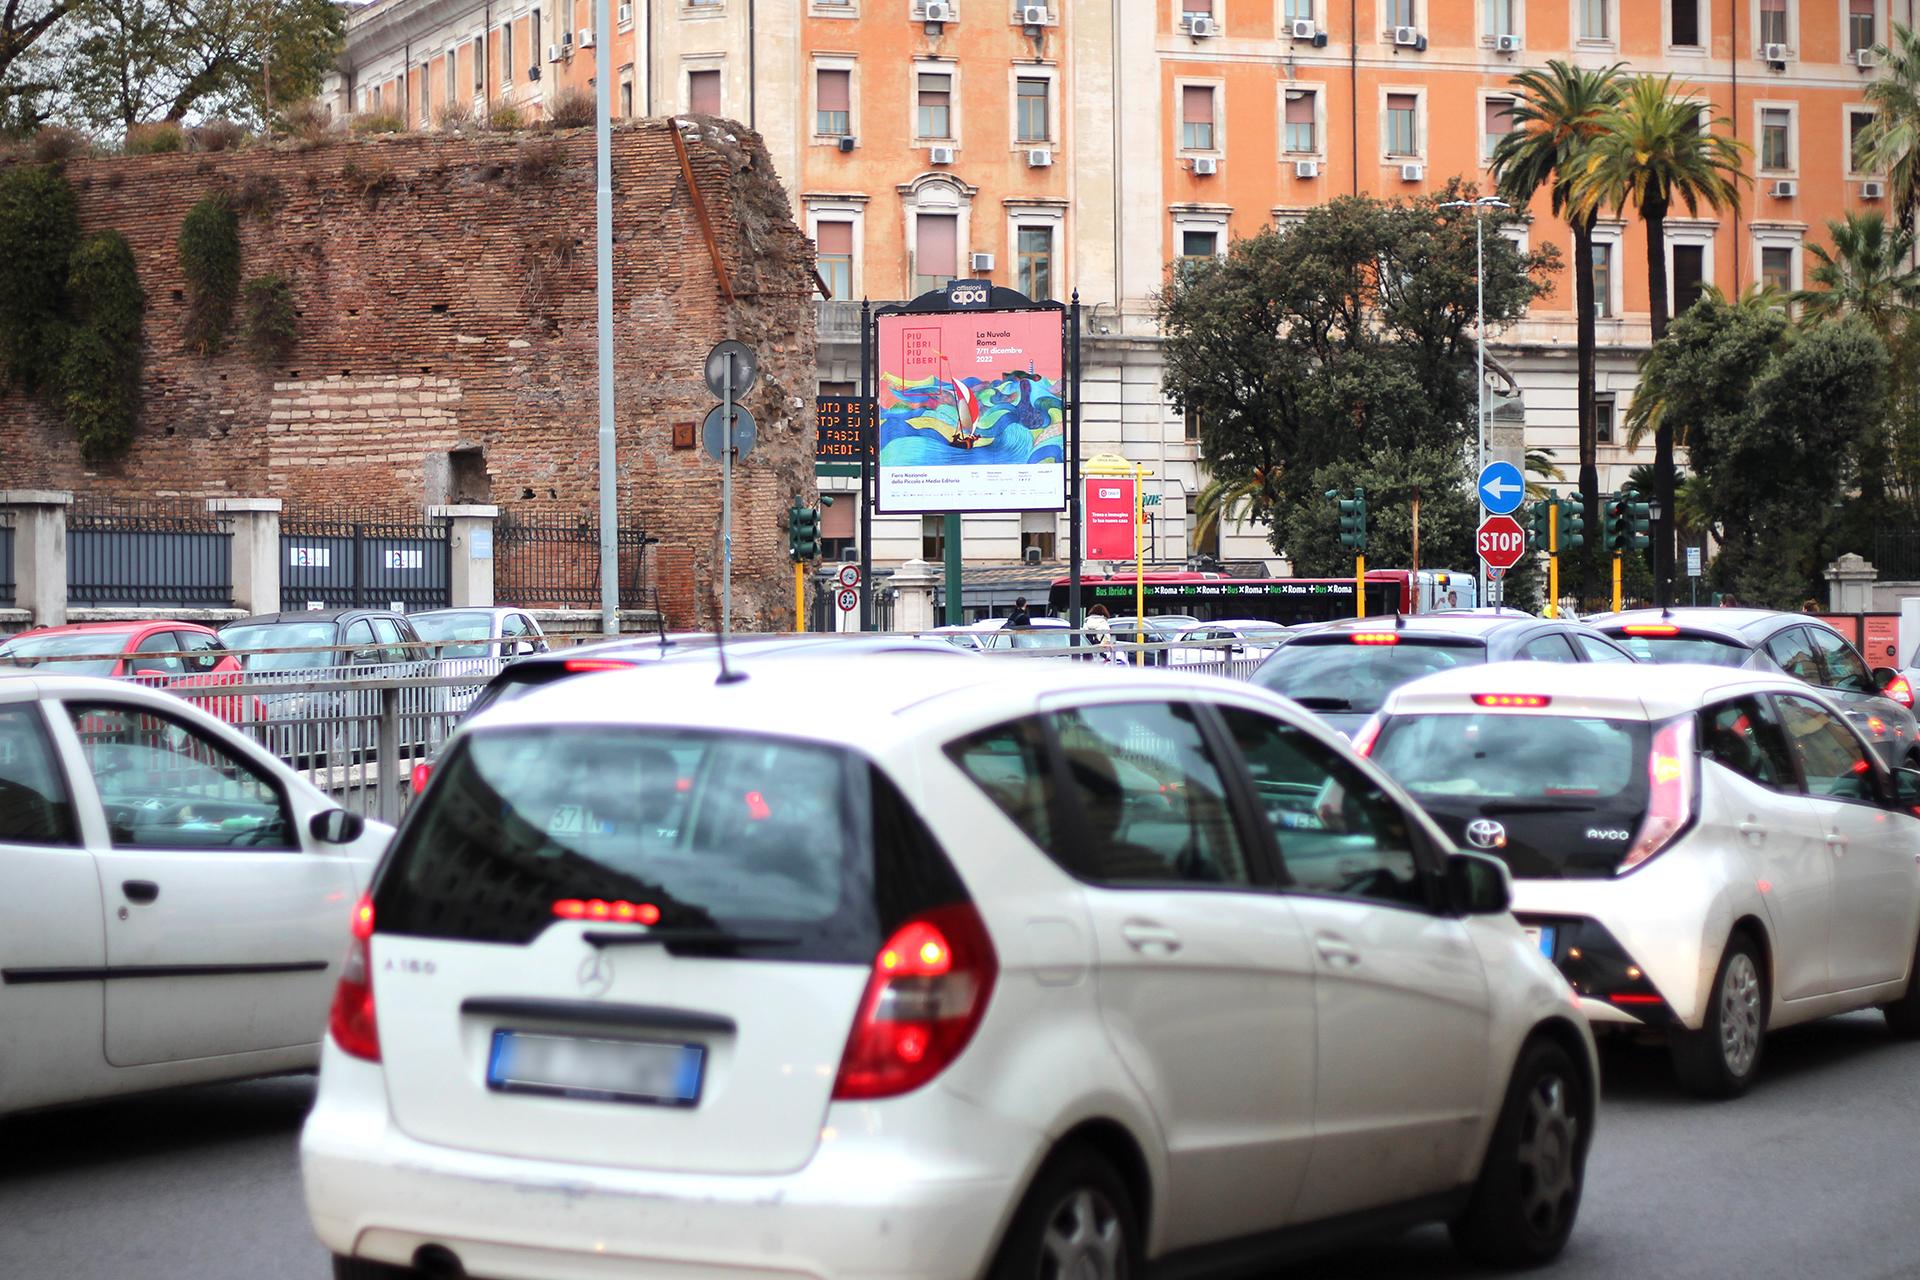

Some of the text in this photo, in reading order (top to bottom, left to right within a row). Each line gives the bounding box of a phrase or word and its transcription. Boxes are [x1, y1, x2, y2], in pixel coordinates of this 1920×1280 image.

[951, 290, 987, 305] apa
[976, 331, 985, 339] La
[976, 339, 997, 347] Roma
[907, 357, 937, 365] LIBERI
[976, 355, 993, 363] 2022
[1480, 532, 1522, 551] STOP
[1096, 587, 1107, 596] Bus
